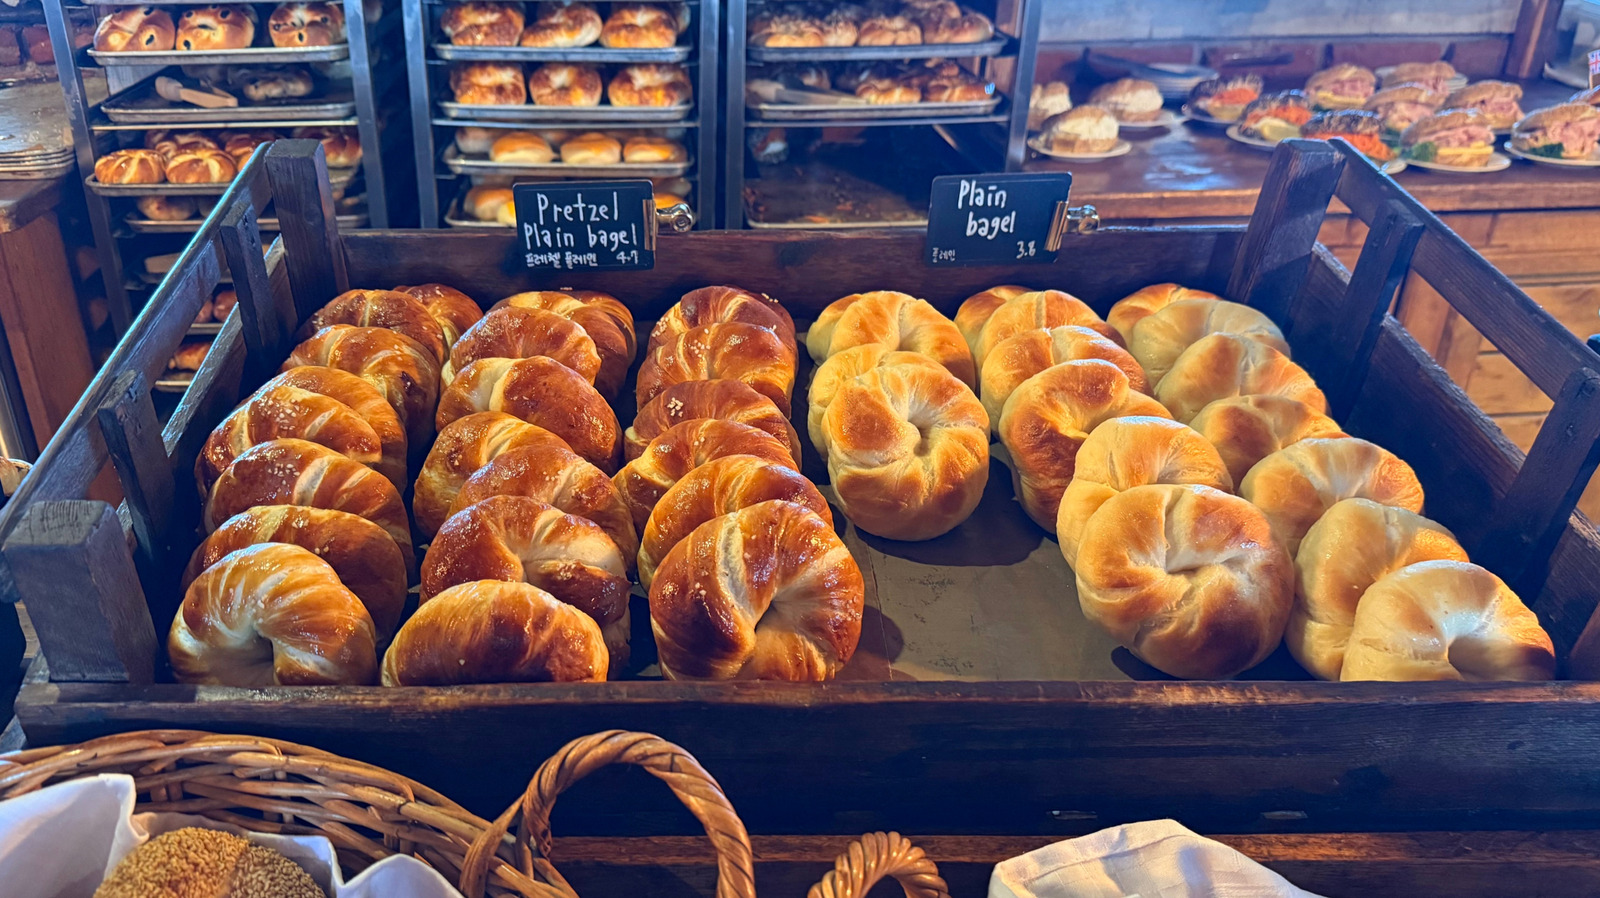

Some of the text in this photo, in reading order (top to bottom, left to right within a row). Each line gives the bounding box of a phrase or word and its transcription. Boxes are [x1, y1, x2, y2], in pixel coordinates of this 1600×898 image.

[537, 191, 619, 226] Pretzel
[957, 179, 1007, 209] Plain
[523, 222, 638, 252] Plain bagel
[965, 210, 1016, 240] bagel
[616, 250, 639, 265] 4.7
[1016, 240, 1036, 260] 3.8
